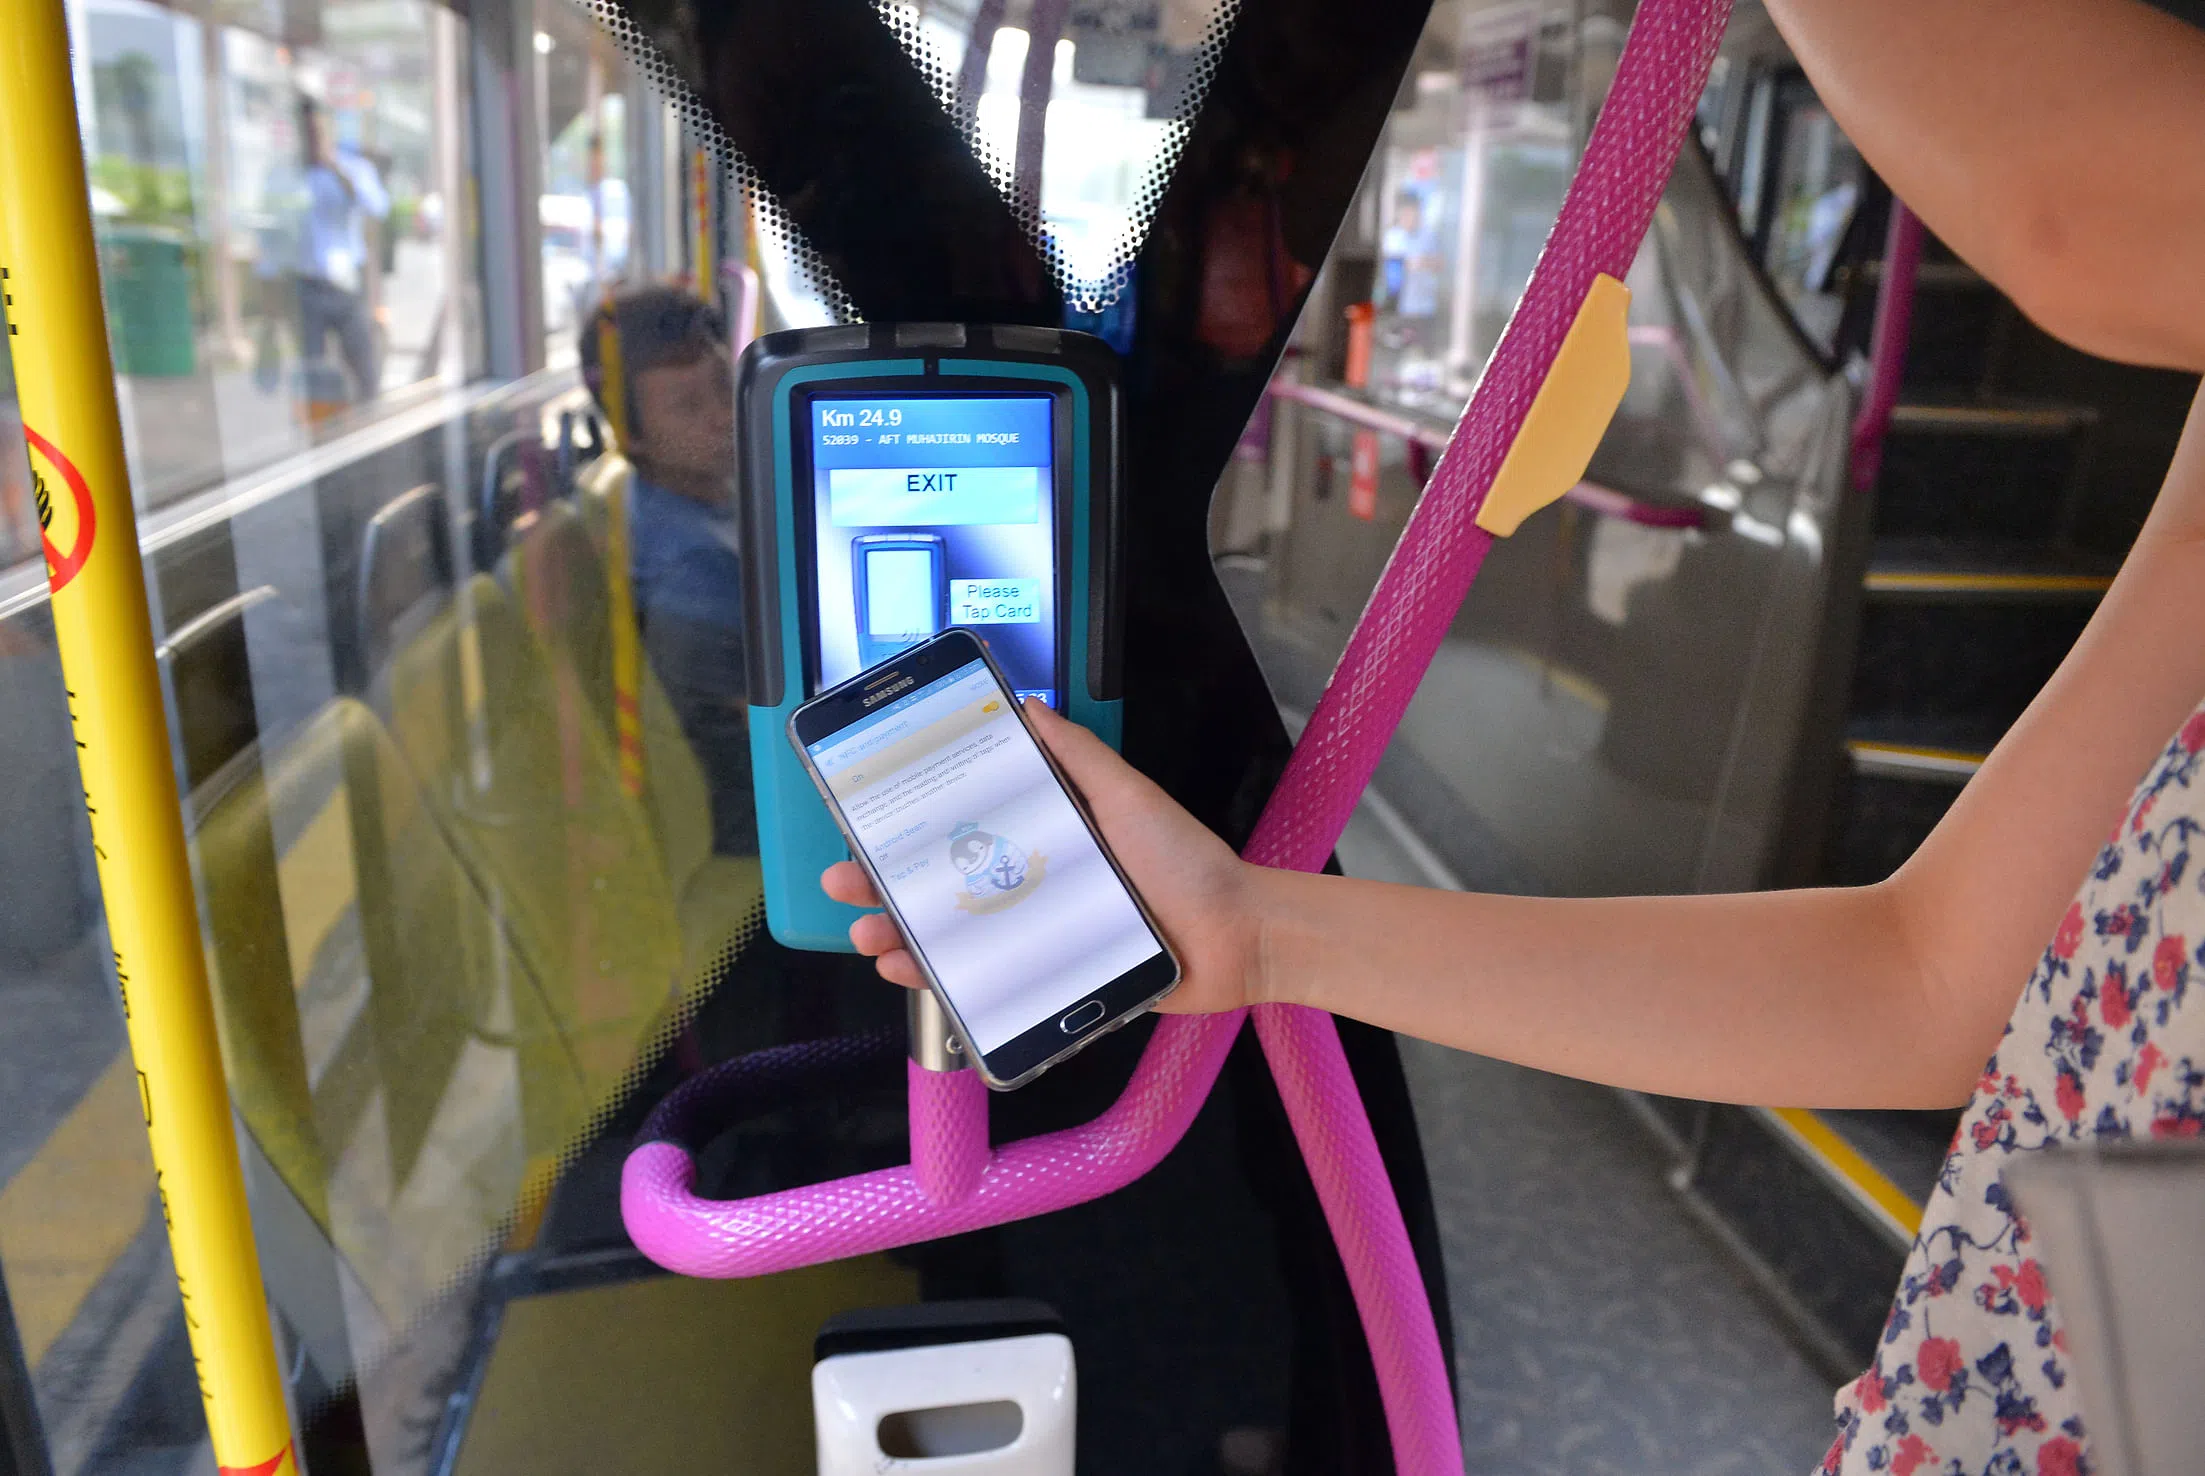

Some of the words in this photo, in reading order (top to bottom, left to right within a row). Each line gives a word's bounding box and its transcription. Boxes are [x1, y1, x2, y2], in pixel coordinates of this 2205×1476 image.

[822, 409, 854, 427] Km
[859, 409, 902, 427] 24.9
[822, 434, 859, 445] 52039
[878, 434, 901, 445] AFT
[906, 433, 971, 444] MUHAJIRIN
[976, 432, 1020, 446] MOSQUE
[907, 473, 958, 492] EXIT
[967, 584, 1019, 598] Please
[962, 604, 990, 620] Tap
[995, 604, 1032, 618] Card
[862, 676, 915, 707] SAMSUNG
[923, 755, 951, 775] payment
[852, 774, 865, 783] On
